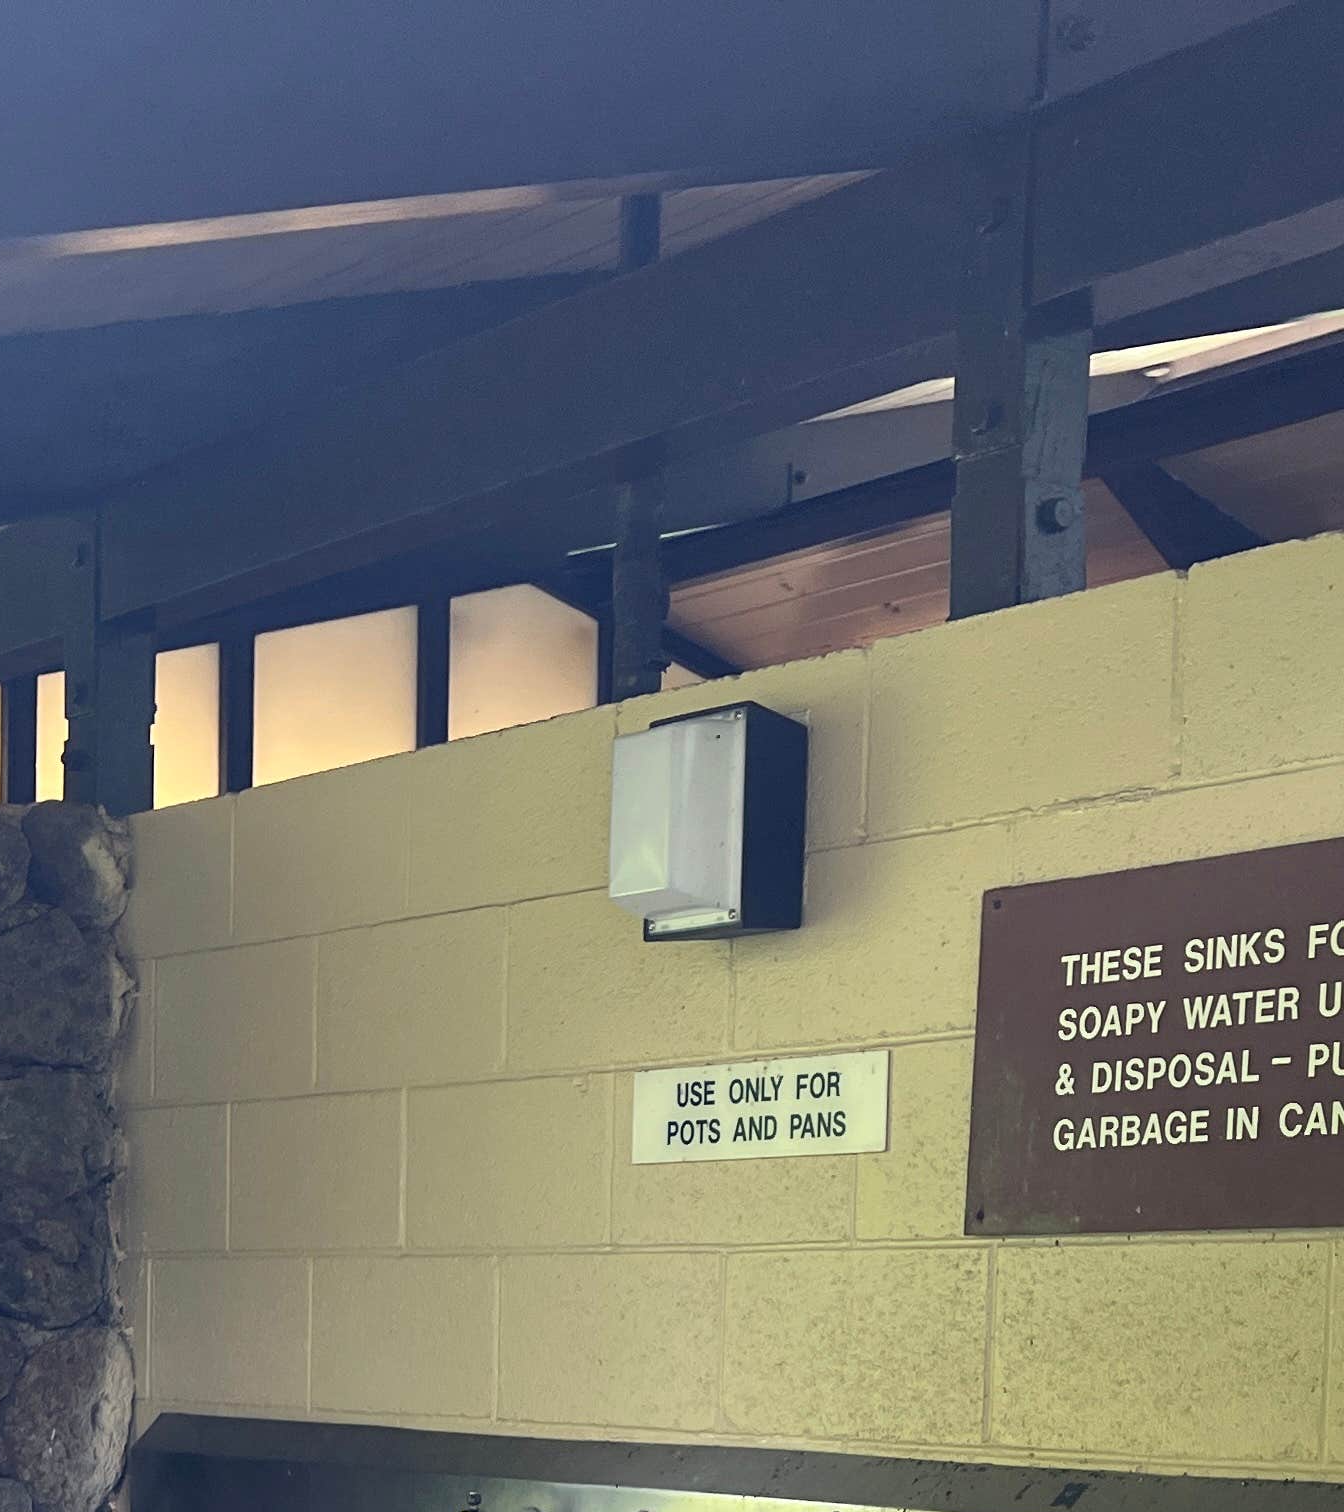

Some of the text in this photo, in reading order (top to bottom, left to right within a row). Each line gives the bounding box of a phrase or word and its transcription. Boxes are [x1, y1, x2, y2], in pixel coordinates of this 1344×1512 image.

[1060, 944, 1163, 987] THESE
[1184, 928, 1285, 973] SINKS
[1057, 1000, 1167, 1041] SOAPY
[1183, 986, 1300, 1030] WATER
[676, 1071, 841, 1108] USE ONLY FOR
[1054, 1063, 1075, 1096] &
[1091, 1049, 1260, 1094] DISPOSAL
[666, 1110, 846, 1146] POTS AND PANS
[1053, 1109, 1210, 1151] GARBAGE
[1226, 1106, 1259, 1141] IN
